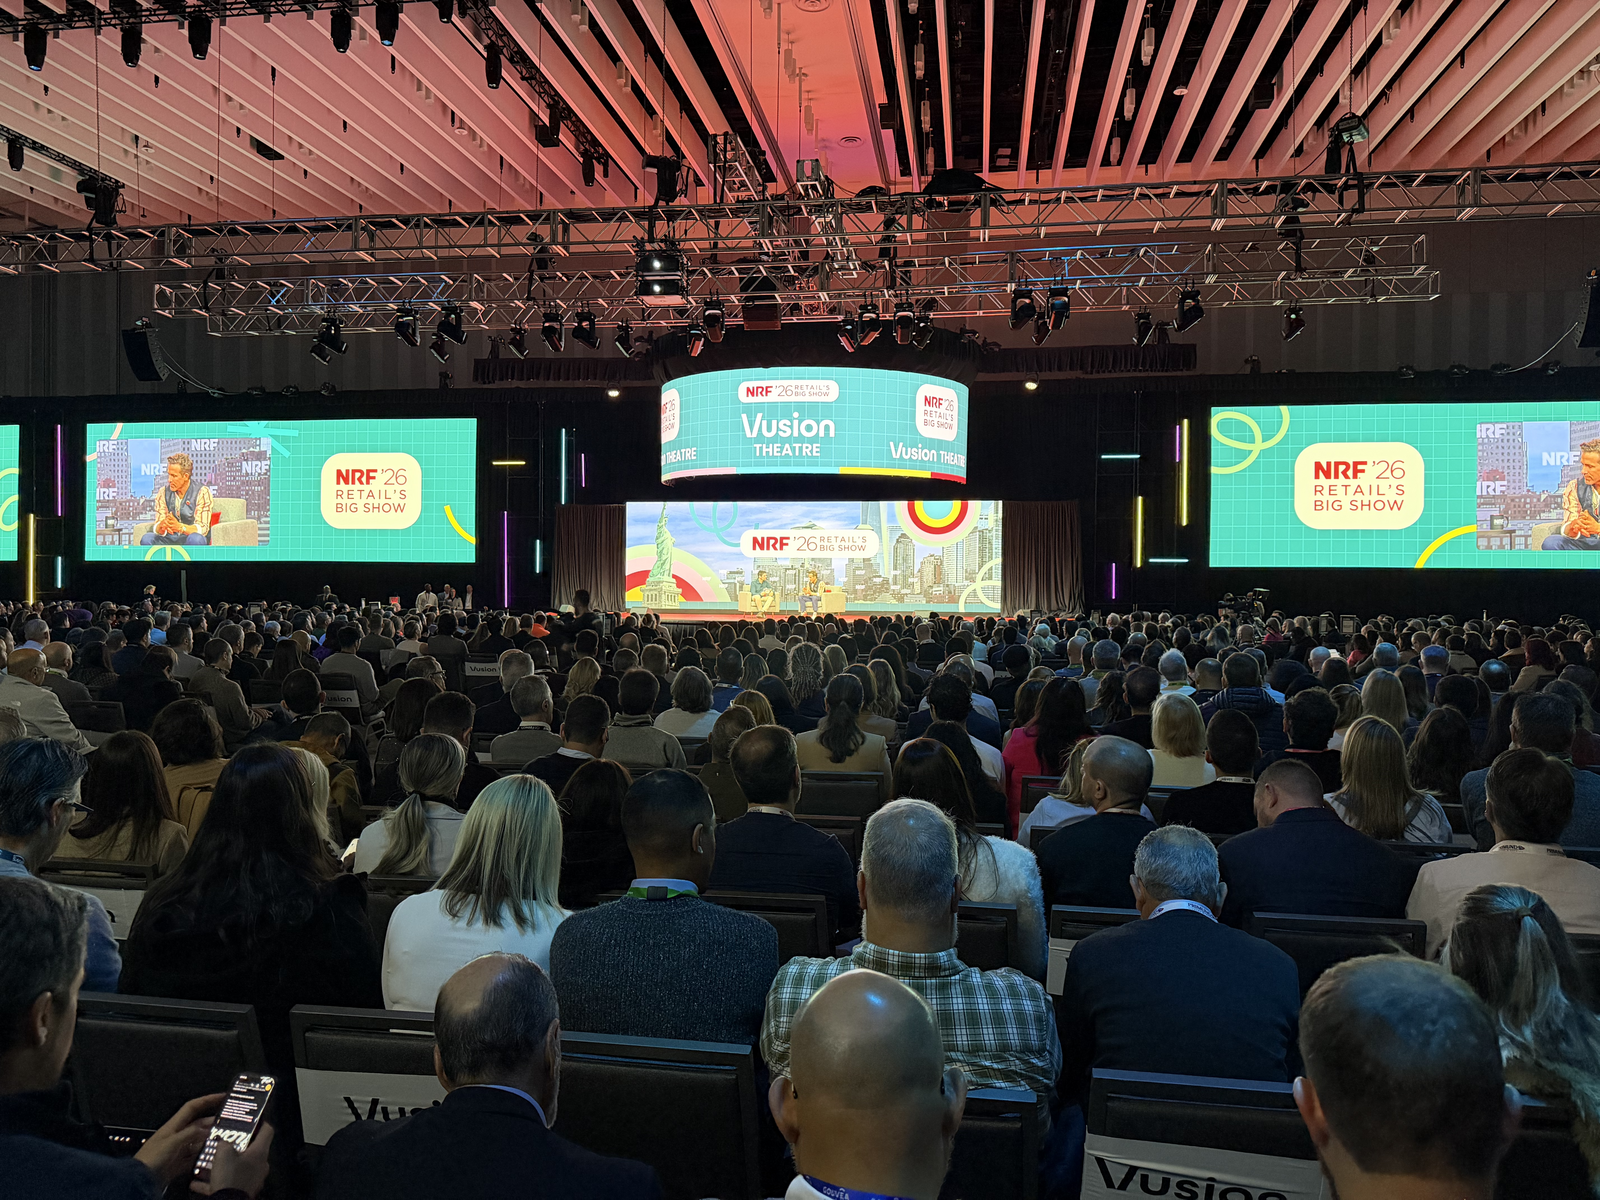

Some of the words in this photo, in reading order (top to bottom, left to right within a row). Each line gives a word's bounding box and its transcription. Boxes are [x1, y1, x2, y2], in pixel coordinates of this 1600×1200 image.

[746, 385, 773, 398] NRF
[775, 384, 793, 397] '26
[924, 395, 943, 409] NRF
[923, 409, 954, 422] RETAIL'S
[741, 411, 835, 438] Vusion
[923, 418, 935, 428] BIG
[936, 420, 954, 431] SHOW
[191, 438, 219, 451] NRF
[753, 443, 821, 457] THEATRE
[666, 447, 697, 464] THEATRE
[889, 441, 937, 462] Vusion
[939, 450, 966, 468] THEATRE
[1542, 451, 1581, 466] NRF
[140, 463, 168, 476] NRF
[241, 460, 270, 474] NRF
[1314, 460, 1368, 480] NRF
[1372, 459, 1406, 480] '26
[336, 468, 378, 486] NRF
[380, 467, 408, 486] '26
[335, 489, 407, 500] RETAIL'S
[1314, 484, 1405, 496] RETAIL'S
[335, 502, 359, 513] BIG
[363, 502, 406, 513] SHOW
[1314, 499, 1343, 512] BIG
[1349, 499, 1404, 512] SHOW
[752, 536, 790, 551] NRF
[793, 535, 818, 552] '26
[819, 535, 867, 544] RETAIL'S
[819, 544, 835, 552] BIG
[837, 544, 867, 552] SHOW
[469, 665, 498, 673] Vusion
[325, 694, 354, 703] usion
